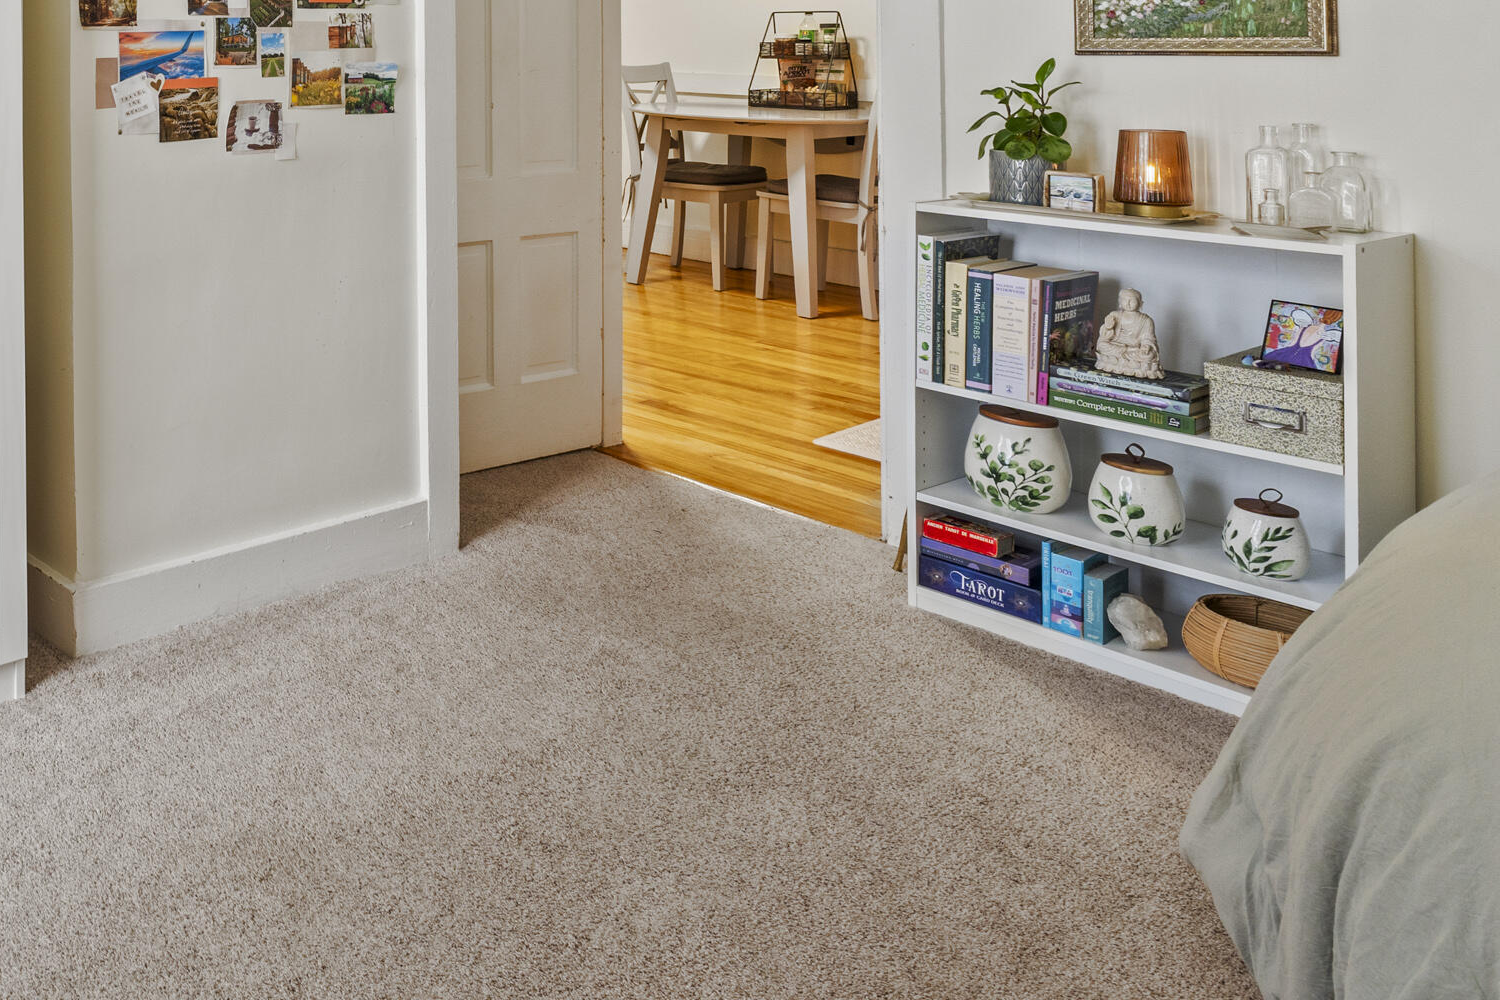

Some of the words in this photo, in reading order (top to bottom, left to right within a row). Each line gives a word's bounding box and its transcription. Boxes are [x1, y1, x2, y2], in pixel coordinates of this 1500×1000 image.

[1055, 295, 1091, 310] MEDICINAL
[947, 308, 962, 337] Pharmacy
[1054, 309, 1076, 322] HERBS
[1077, 399, 1115, 412] Complete
[1118, 407, 1147, 419] Herbal
[945, 526, 959, 534] TAROT
[950, 570, 1004, 601] TAROT
